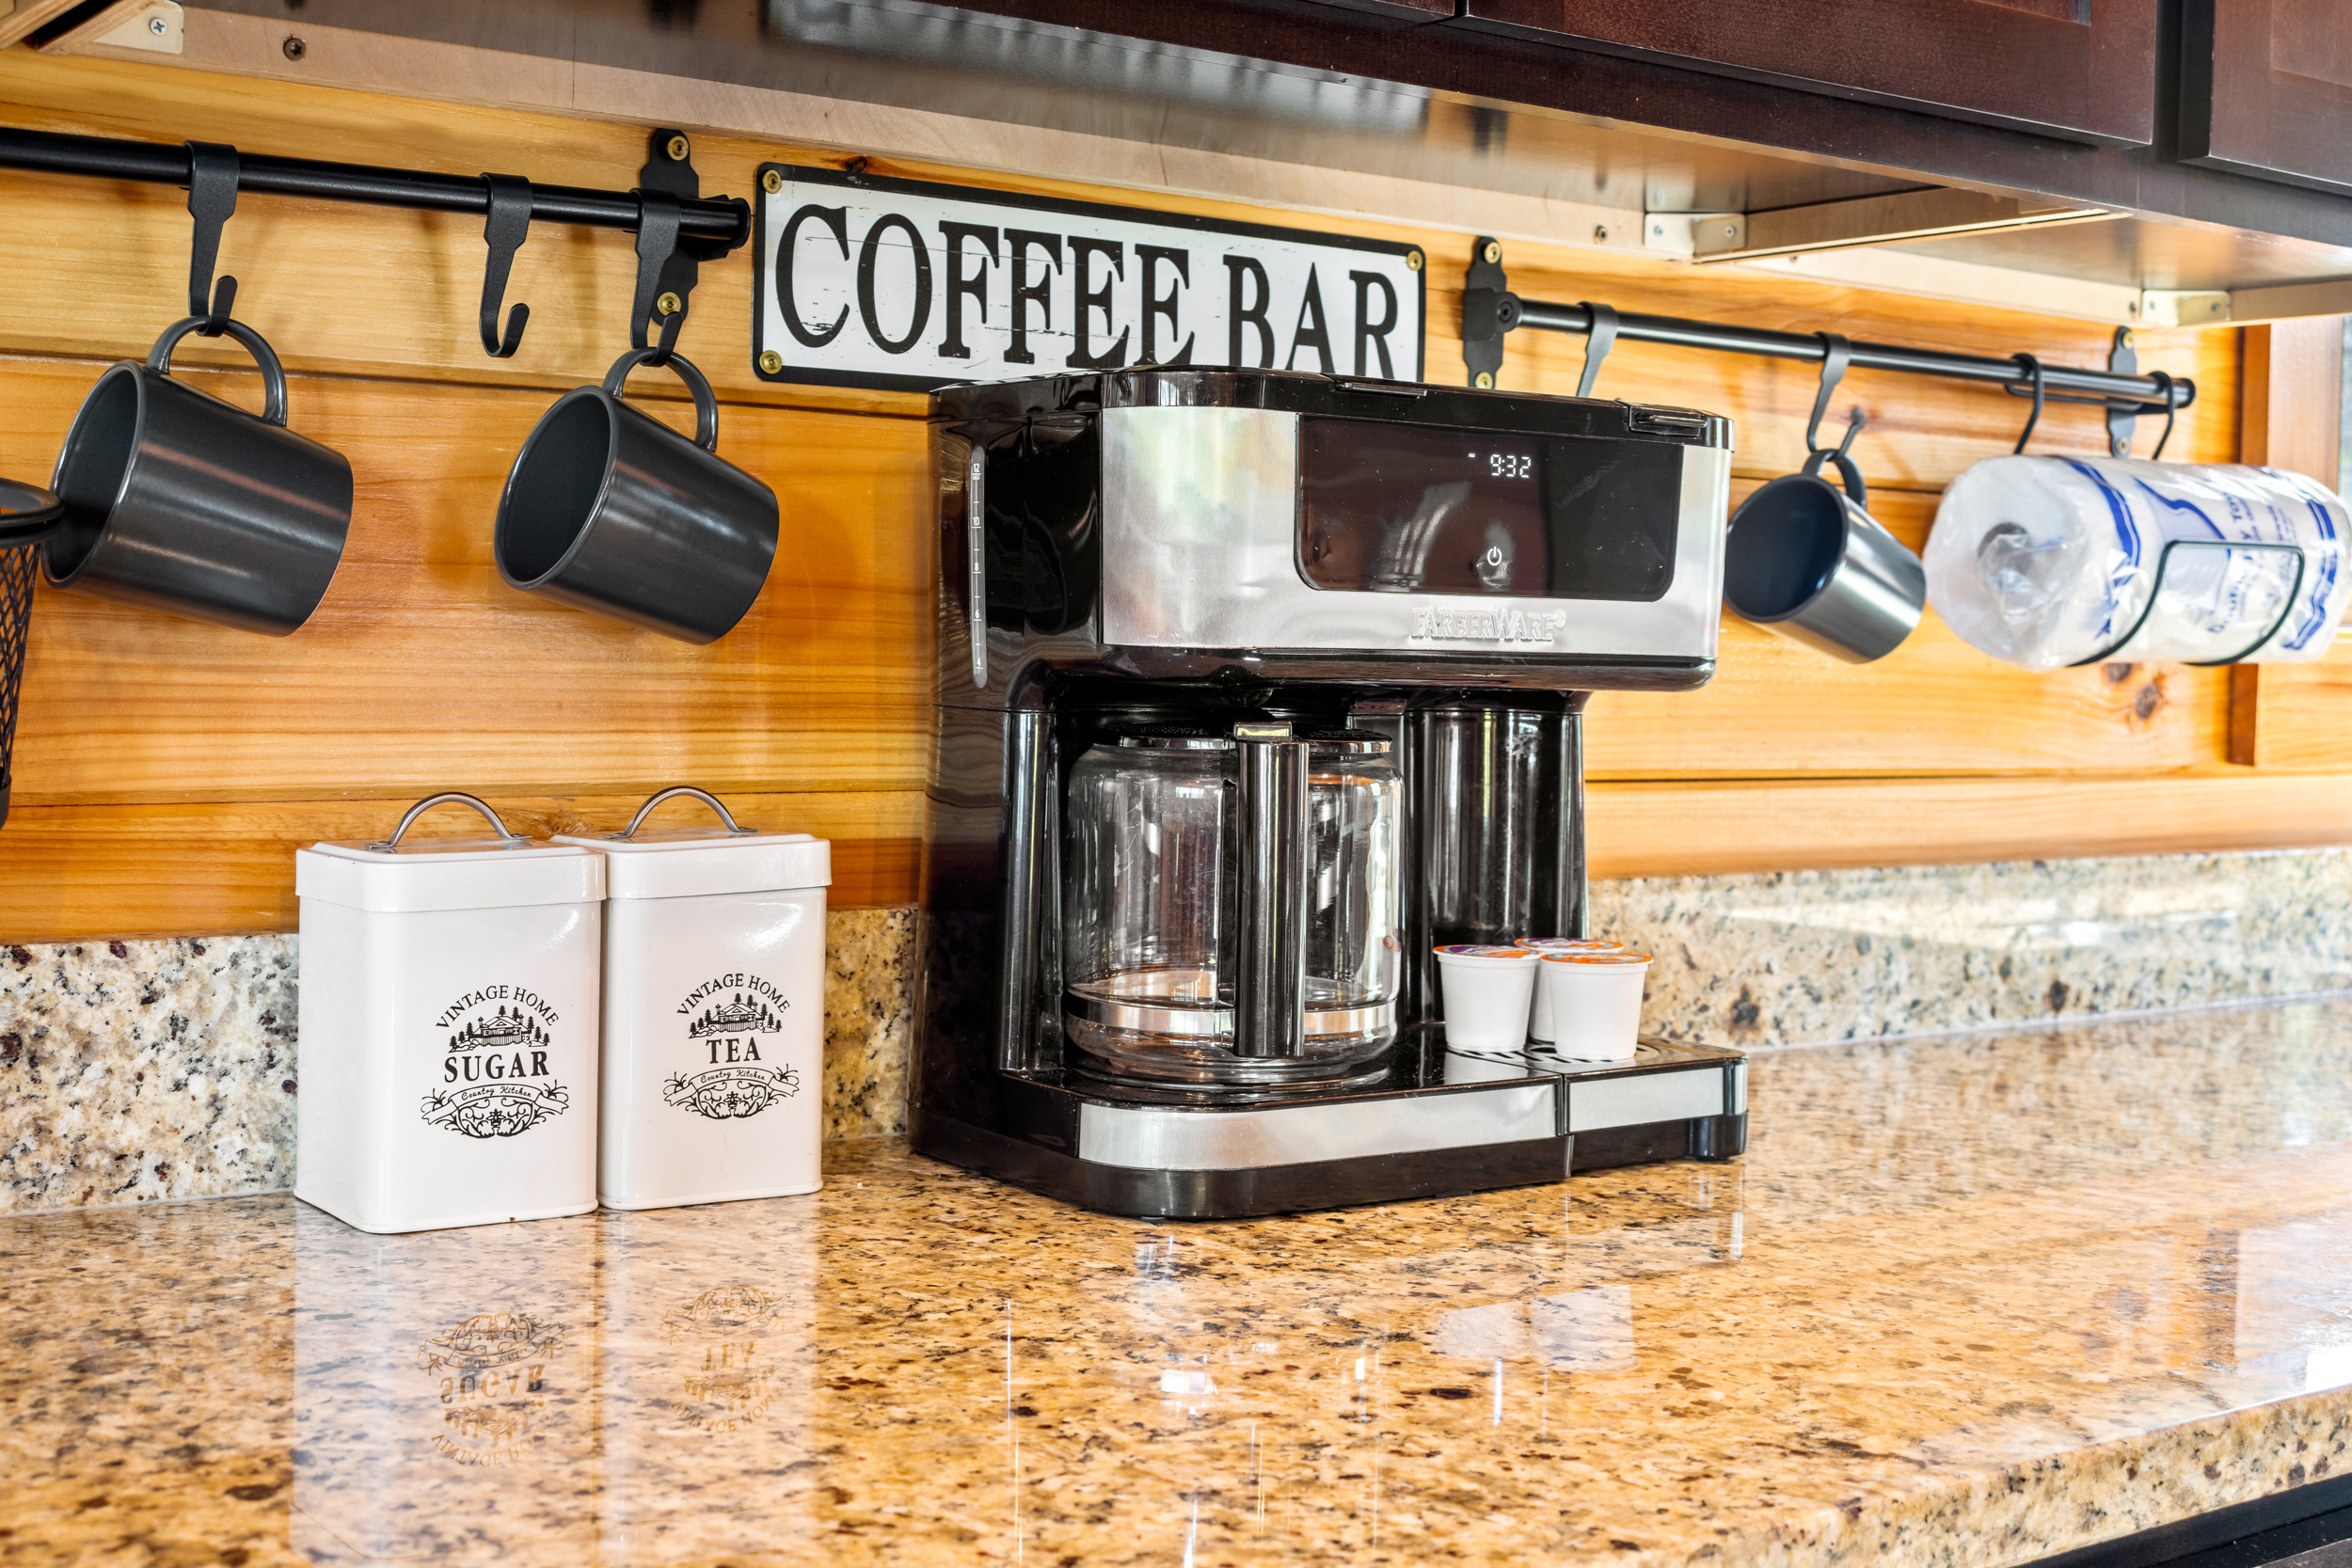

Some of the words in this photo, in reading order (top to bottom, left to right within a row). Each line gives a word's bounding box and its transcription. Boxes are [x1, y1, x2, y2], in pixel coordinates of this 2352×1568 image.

[775, 203, 1197, 371] COFFEE
[1222, 253, 1402, 381] BAR
[973, 463, 980, 473] 12
[1490, 453, 1532, 479] 9:32
[973, 516, 980, 526] 10
[974, 562, 979, 572] 8
[975, 609, 980, 619] 6
[976, 657, 981, 667] 4
[675, 973, 744, 1016] VINTAGE
[748, 974, 791, 1014] HOME
[436, 985, 509, 1029] VINTAGE
[513, 987, 560, 1026] HOME
[706, 1037, 762, 1065] TEA
[444, 1051, 550, 1083] SUGAR
[700, 1069, 732, 1083] Country
[736, 1069, 766, 1081] Kitchen
[461, 1086, 496, 1101] Country
[500, 1085, 532, 1098] Kitchen
